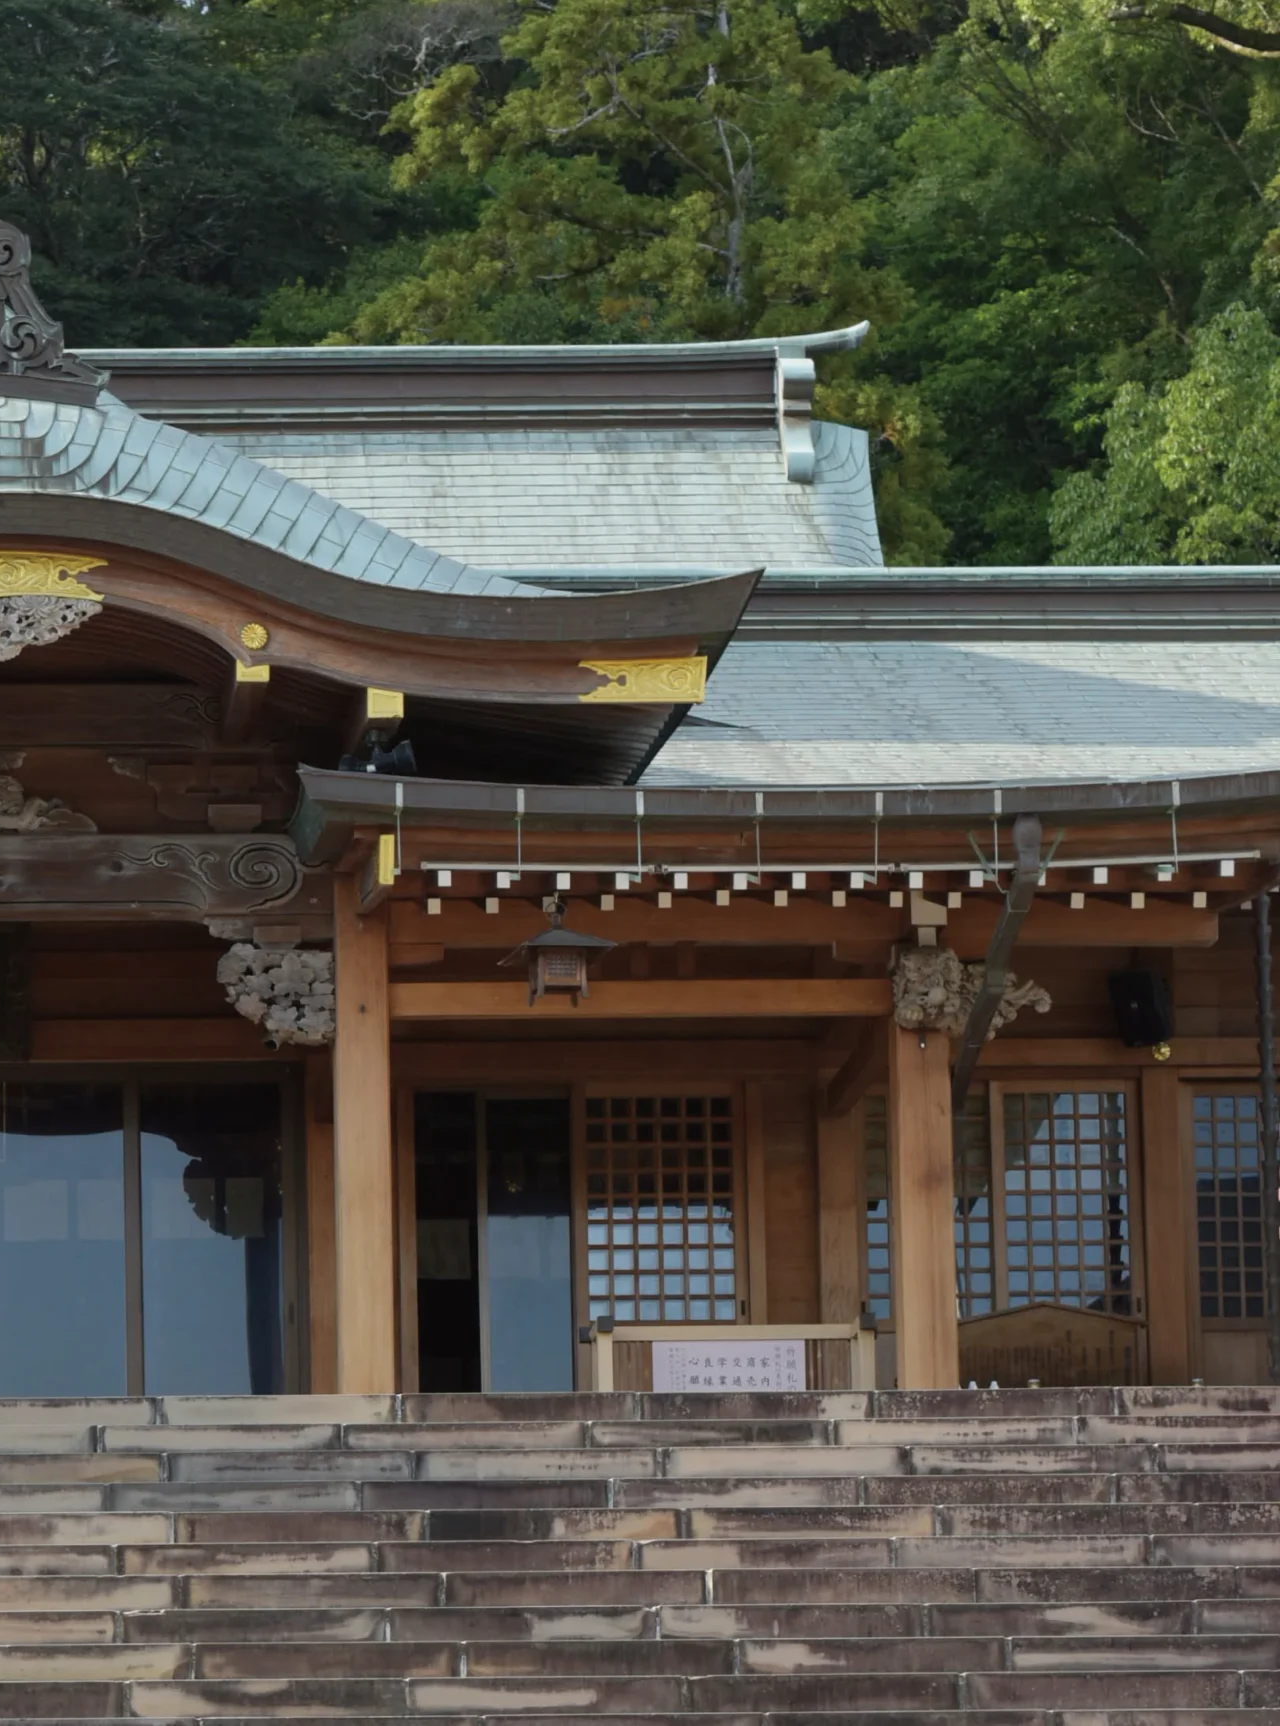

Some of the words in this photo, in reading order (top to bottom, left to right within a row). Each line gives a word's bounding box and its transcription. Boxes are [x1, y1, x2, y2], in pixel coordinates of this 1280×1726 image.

[688, 1356, 700, 1385] 心願
[703, 1357, 714, 1386] 良縁
[716, 1356, 728, 1386] 学業
[731, 1357, 742, 1386] 交通
[746, 1357, 757, 1386] 商売
[759, 1356, 771, 1386] 家内
